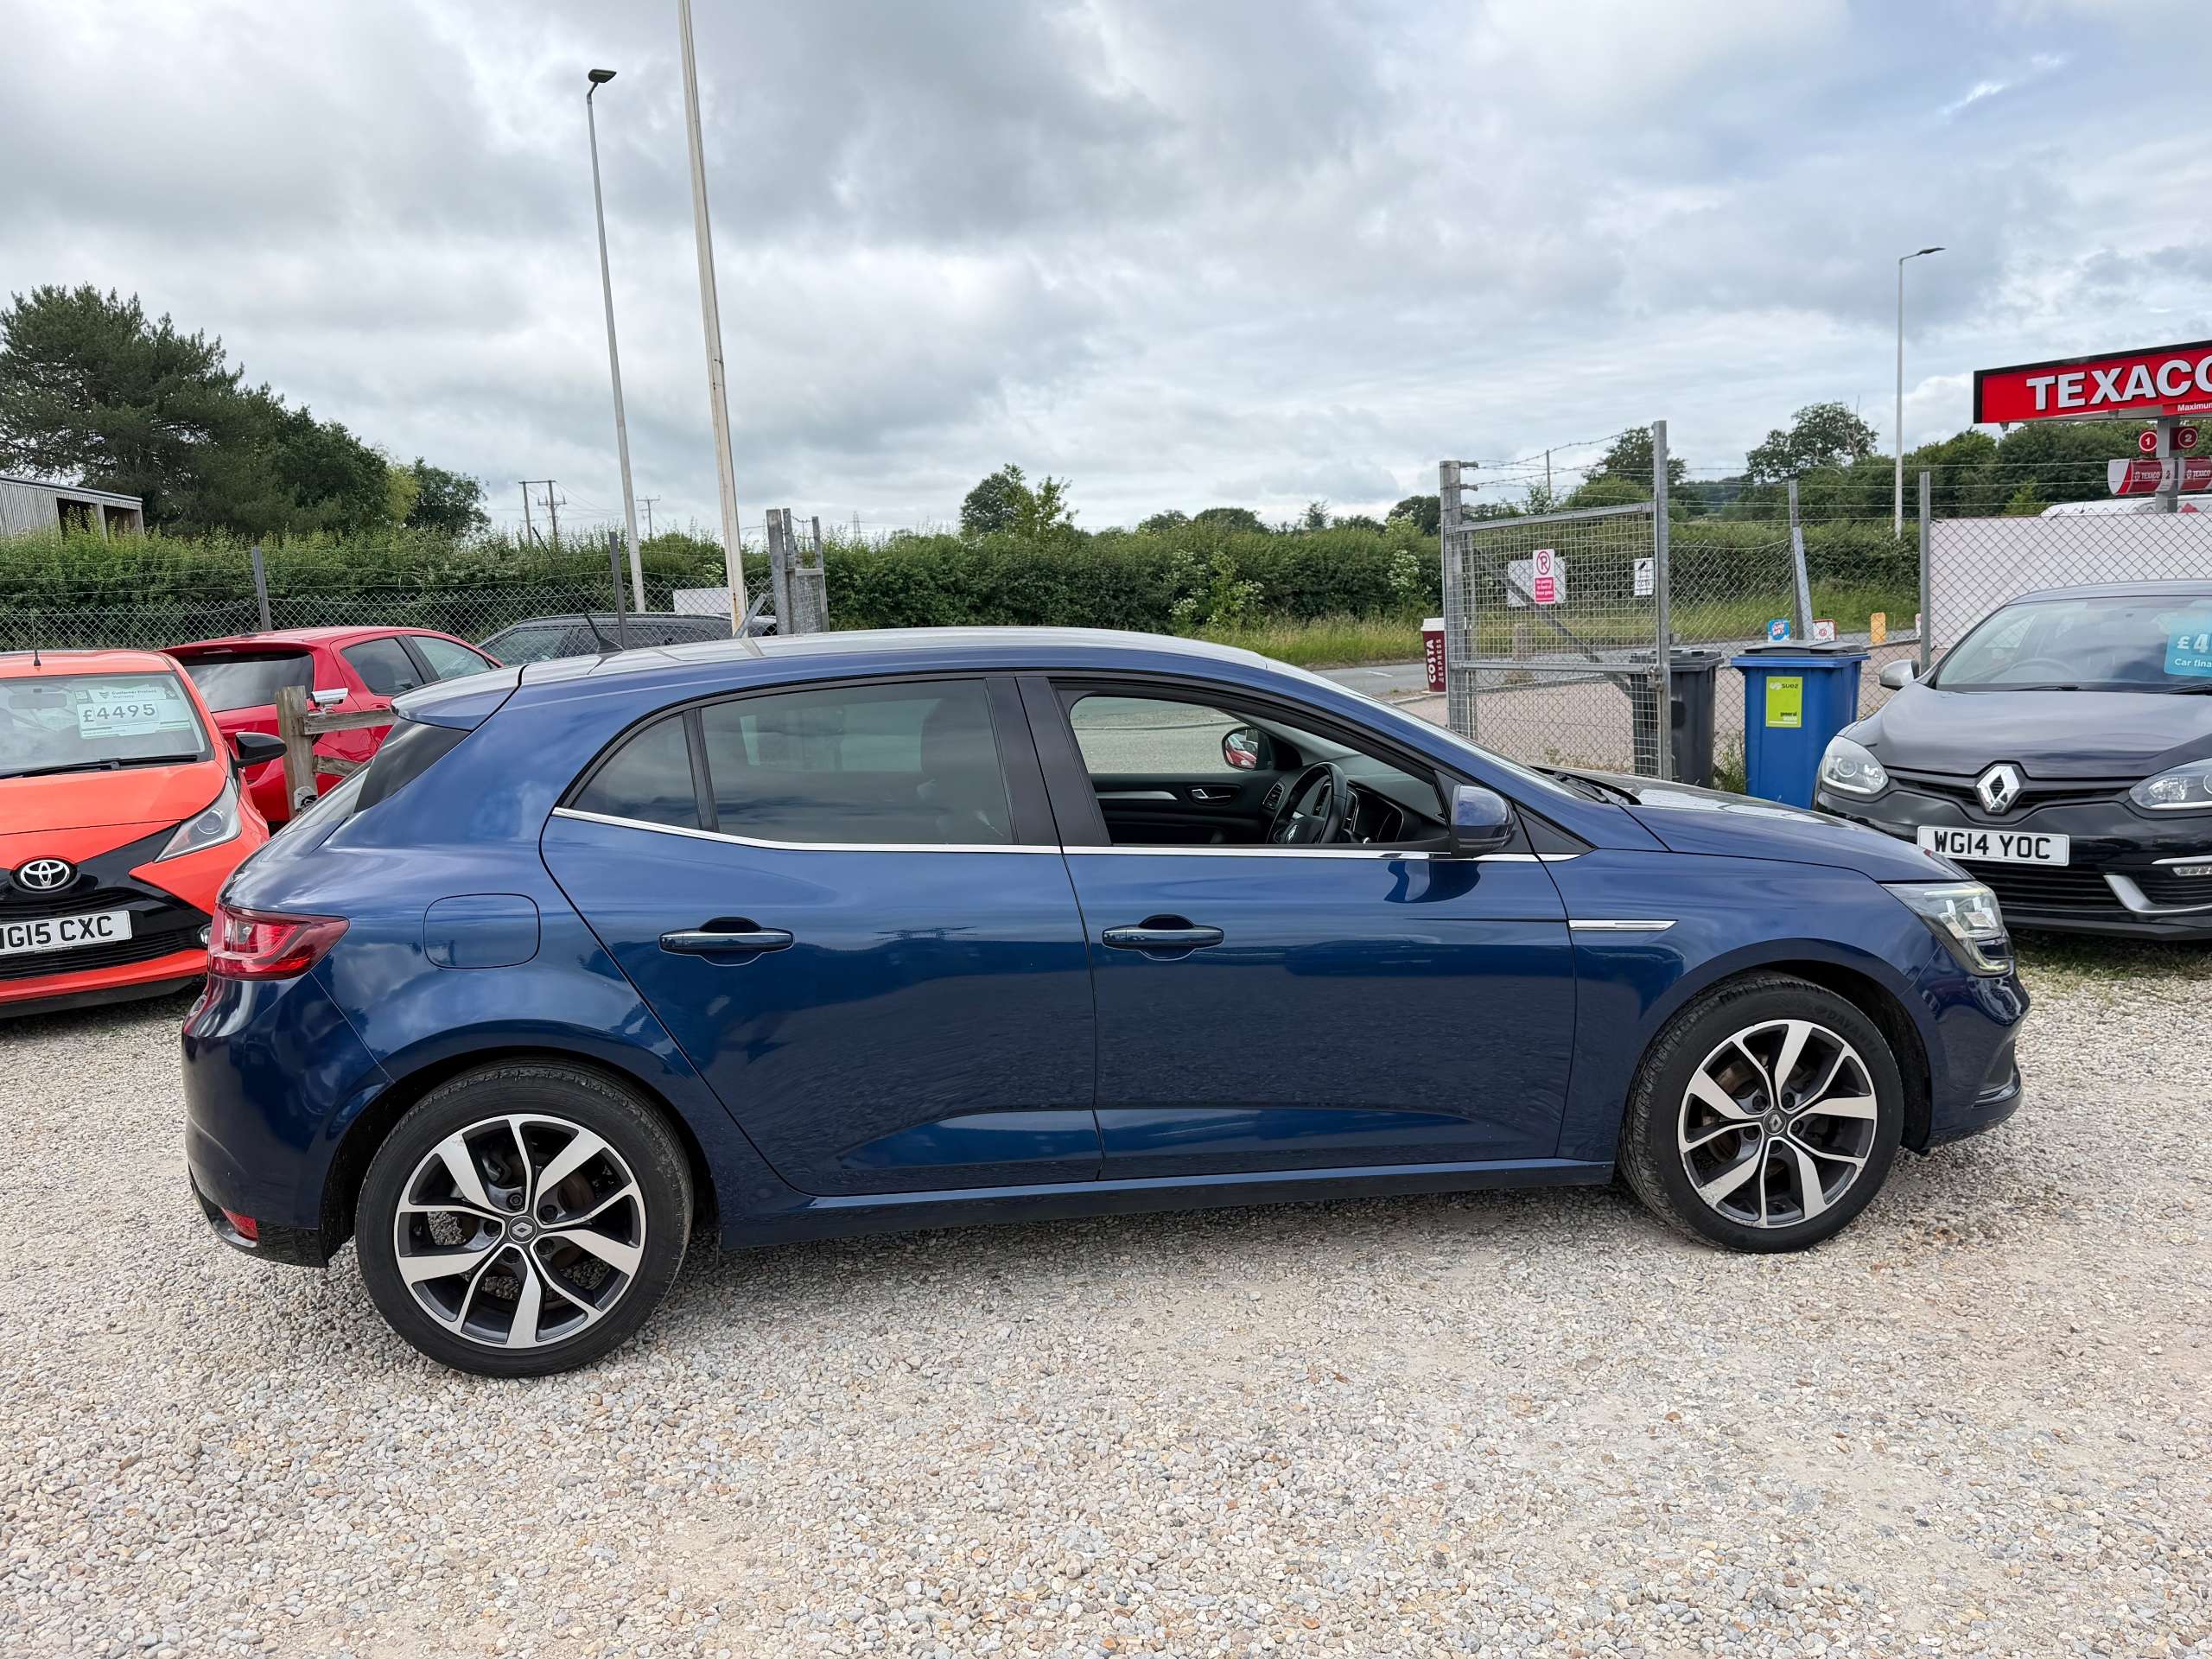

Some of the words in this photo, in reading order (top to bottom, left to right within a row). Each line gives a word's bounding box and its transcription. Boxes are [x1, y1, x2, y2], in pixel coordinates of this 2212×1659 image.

[2145, 436, 2151, 446] 1
[2184, 434, 2192, 442] 2
[2192, 469, 2211, 478] TEXACO
[1426, 639, 1436, 683] COSTA
[2174, 658, 2191, 666] Car
[82, 703, 156, 722] £4495
[1934, 830, 1989, 855] WG14
[1999, 835, 2051, 860] YOC
[59, 915, 113, 942] CXC
